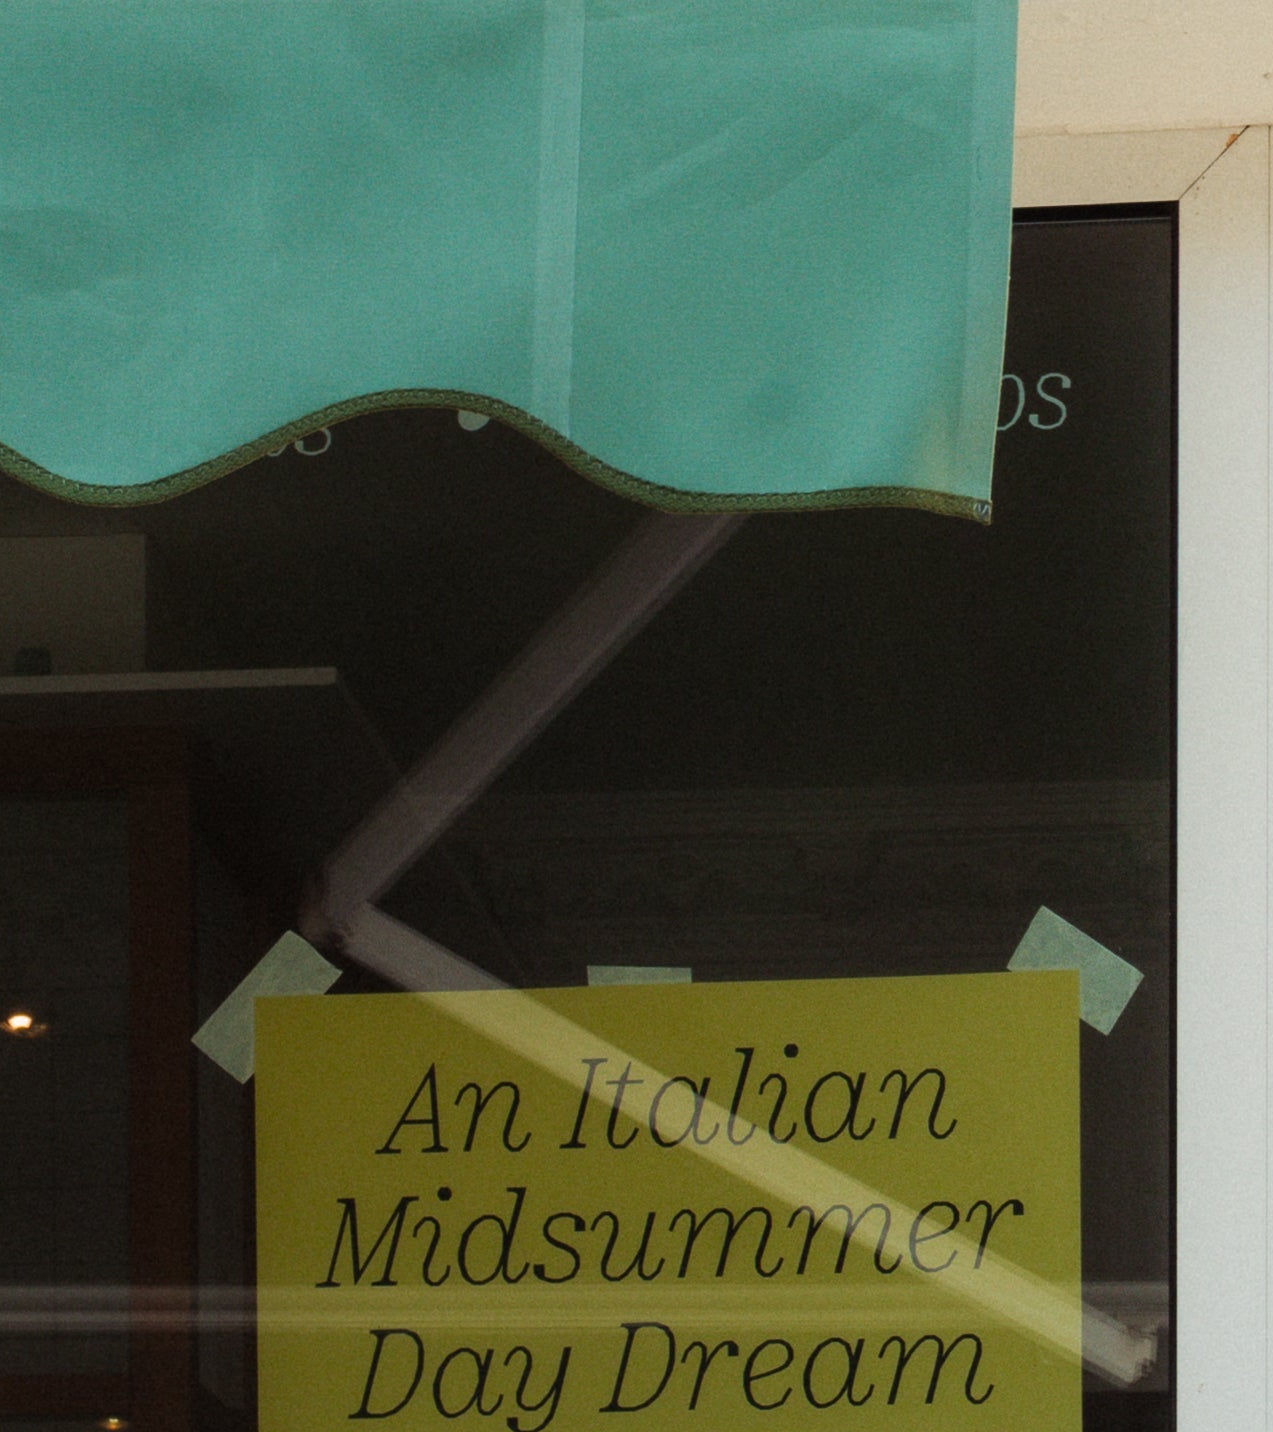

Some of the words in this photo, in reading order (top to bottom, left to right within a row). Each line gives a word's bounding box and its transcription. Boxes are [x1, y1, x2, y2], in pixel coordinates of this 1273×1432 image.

[373, 1062, 530, 1156] An
[558, 1043, 958, 1152] Italian
[315, 1187, 1026, 1288] Midsummer
[600, 1322, 994, 1416] Dream
